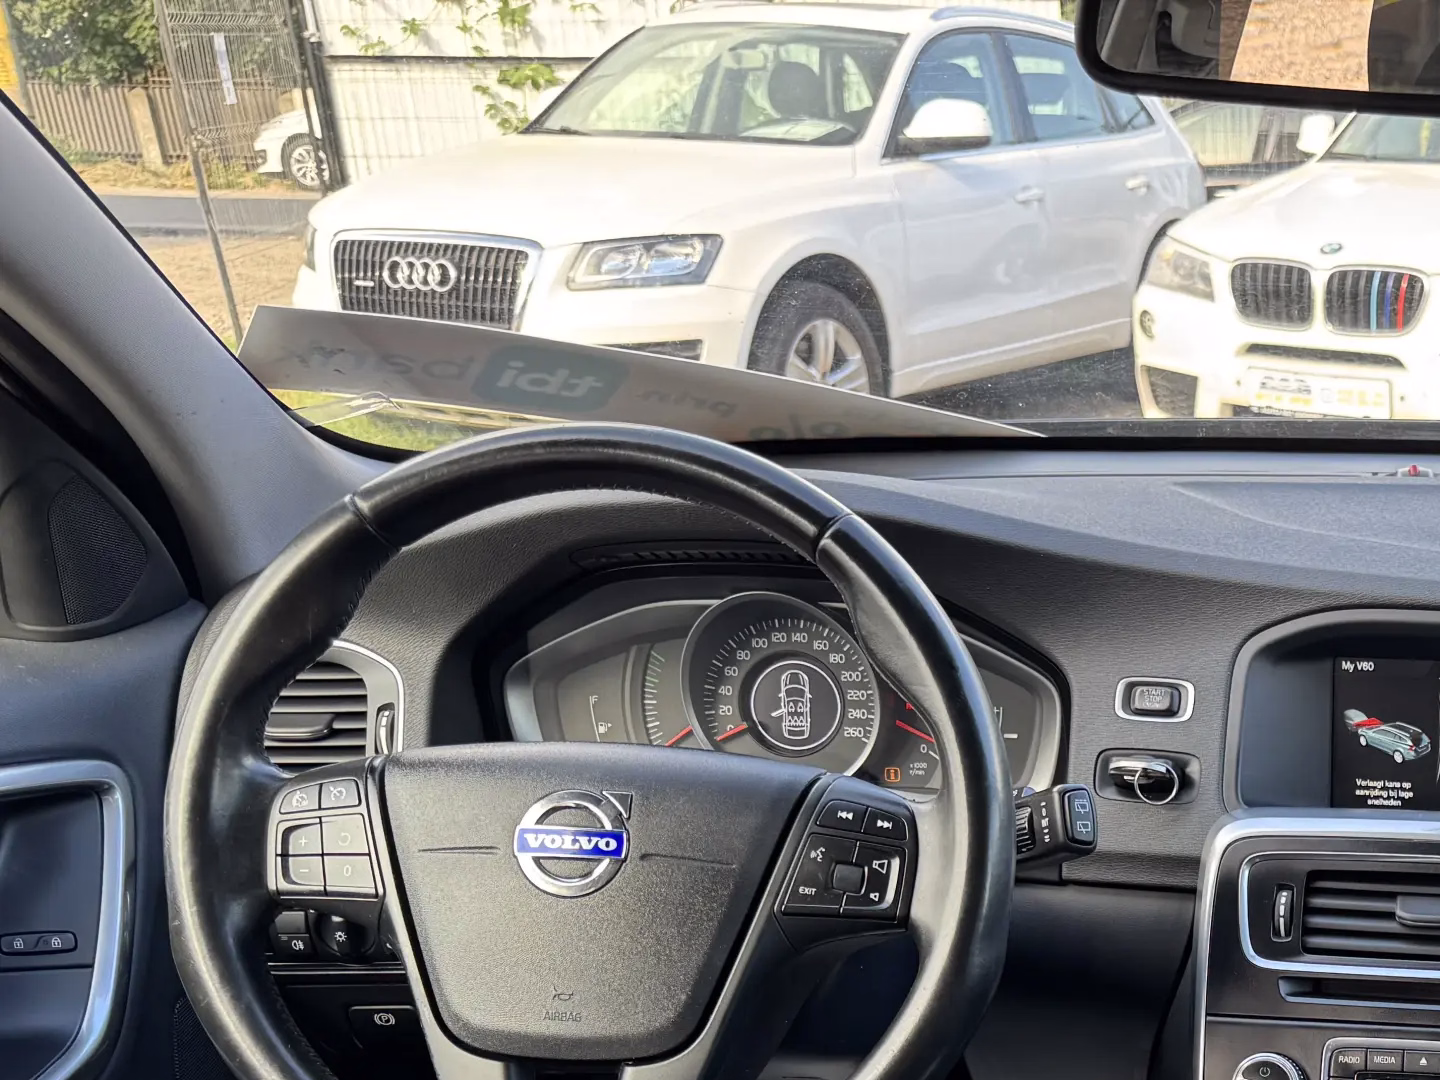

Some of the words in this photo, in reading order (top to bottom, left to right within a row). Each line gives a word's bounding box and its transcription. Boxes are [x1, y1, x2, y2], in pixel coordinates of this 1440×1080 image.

[771, 633, 787, 642] 120
[791, 633, 808, 642] 140
[752, 638, 768, 648] 100
[813, 641, 829, 650] 160
[736, 651, 750, 661] 80
[829, 654, 845, 663] 180
[1342, 661, 1354, 672] My
[1356, 662, 1374, 671] V60
[724, 667, 738, 676] 60
[841, 672, 861, 681] 200
[719, 686, 732, 695] 40
[847, 690, 867, 700] 220
[719, 706, 732, 715] 20
[848, 709, 867, 719] 240
[844, 727, 863, 737] 260
[920, 744, 927, 753] 0
[1389, 790, 1397, 799] bij
[1399, 790, 1414, 799] lage
[523, 833, 618, 851] VOLVO
[799, 886, 817, 895] EXIT
[543, 1011, 581, 1022] AIRBAG
[1338, 1056, 1361, 1064] RADIO
[1374, 1056, 1396, 1064] MEDIA
